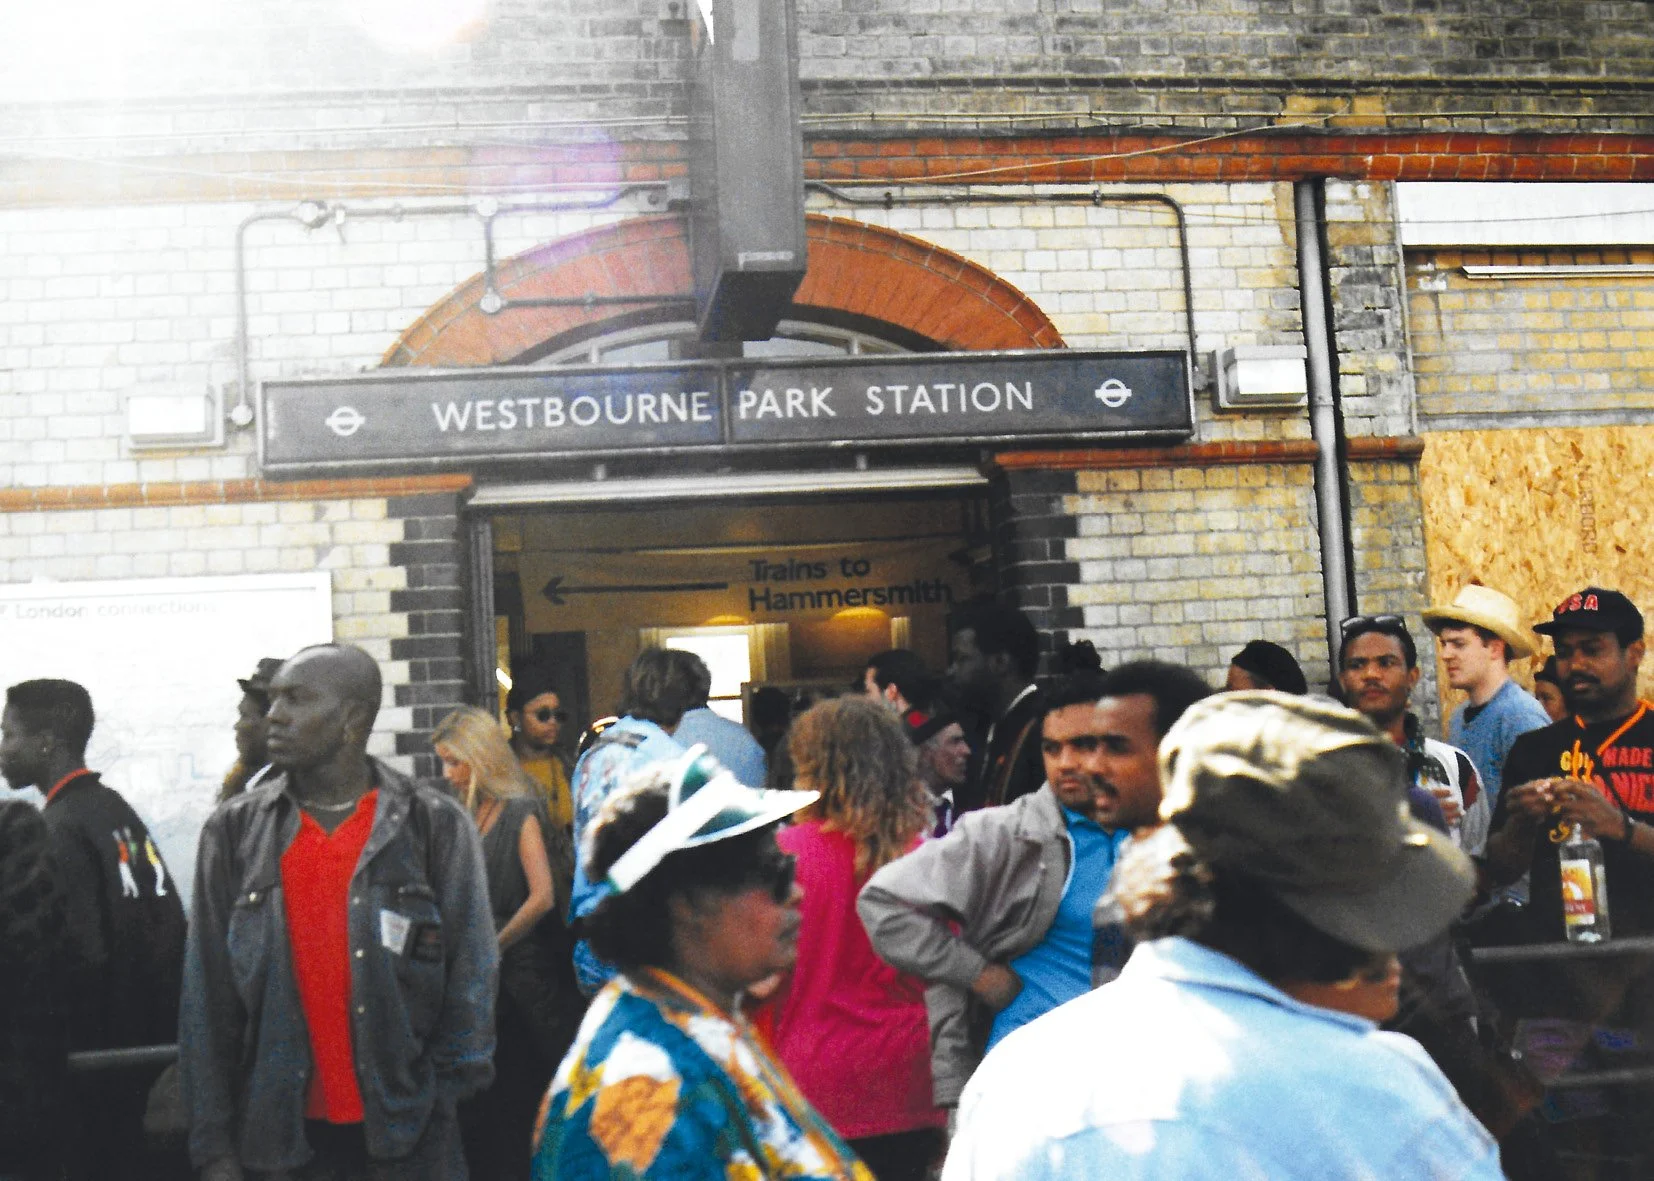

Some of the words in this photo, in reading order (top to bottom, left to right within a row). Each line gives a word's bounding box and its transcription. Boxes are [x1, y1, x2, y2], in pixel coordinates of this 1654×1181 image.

[431, 392, 712, 432] WESTBOURNE
[738, 387, 837, 420] PARK
[866, 381, 1033, 415] STATION
[748, 556, 828, 582] Trains
[838, 556, 871, 578] to
[747, 577, 953, 612] Hammersmith
[15, 601, 88, 619] London
[1602, 746, 1652, 768] MADE
